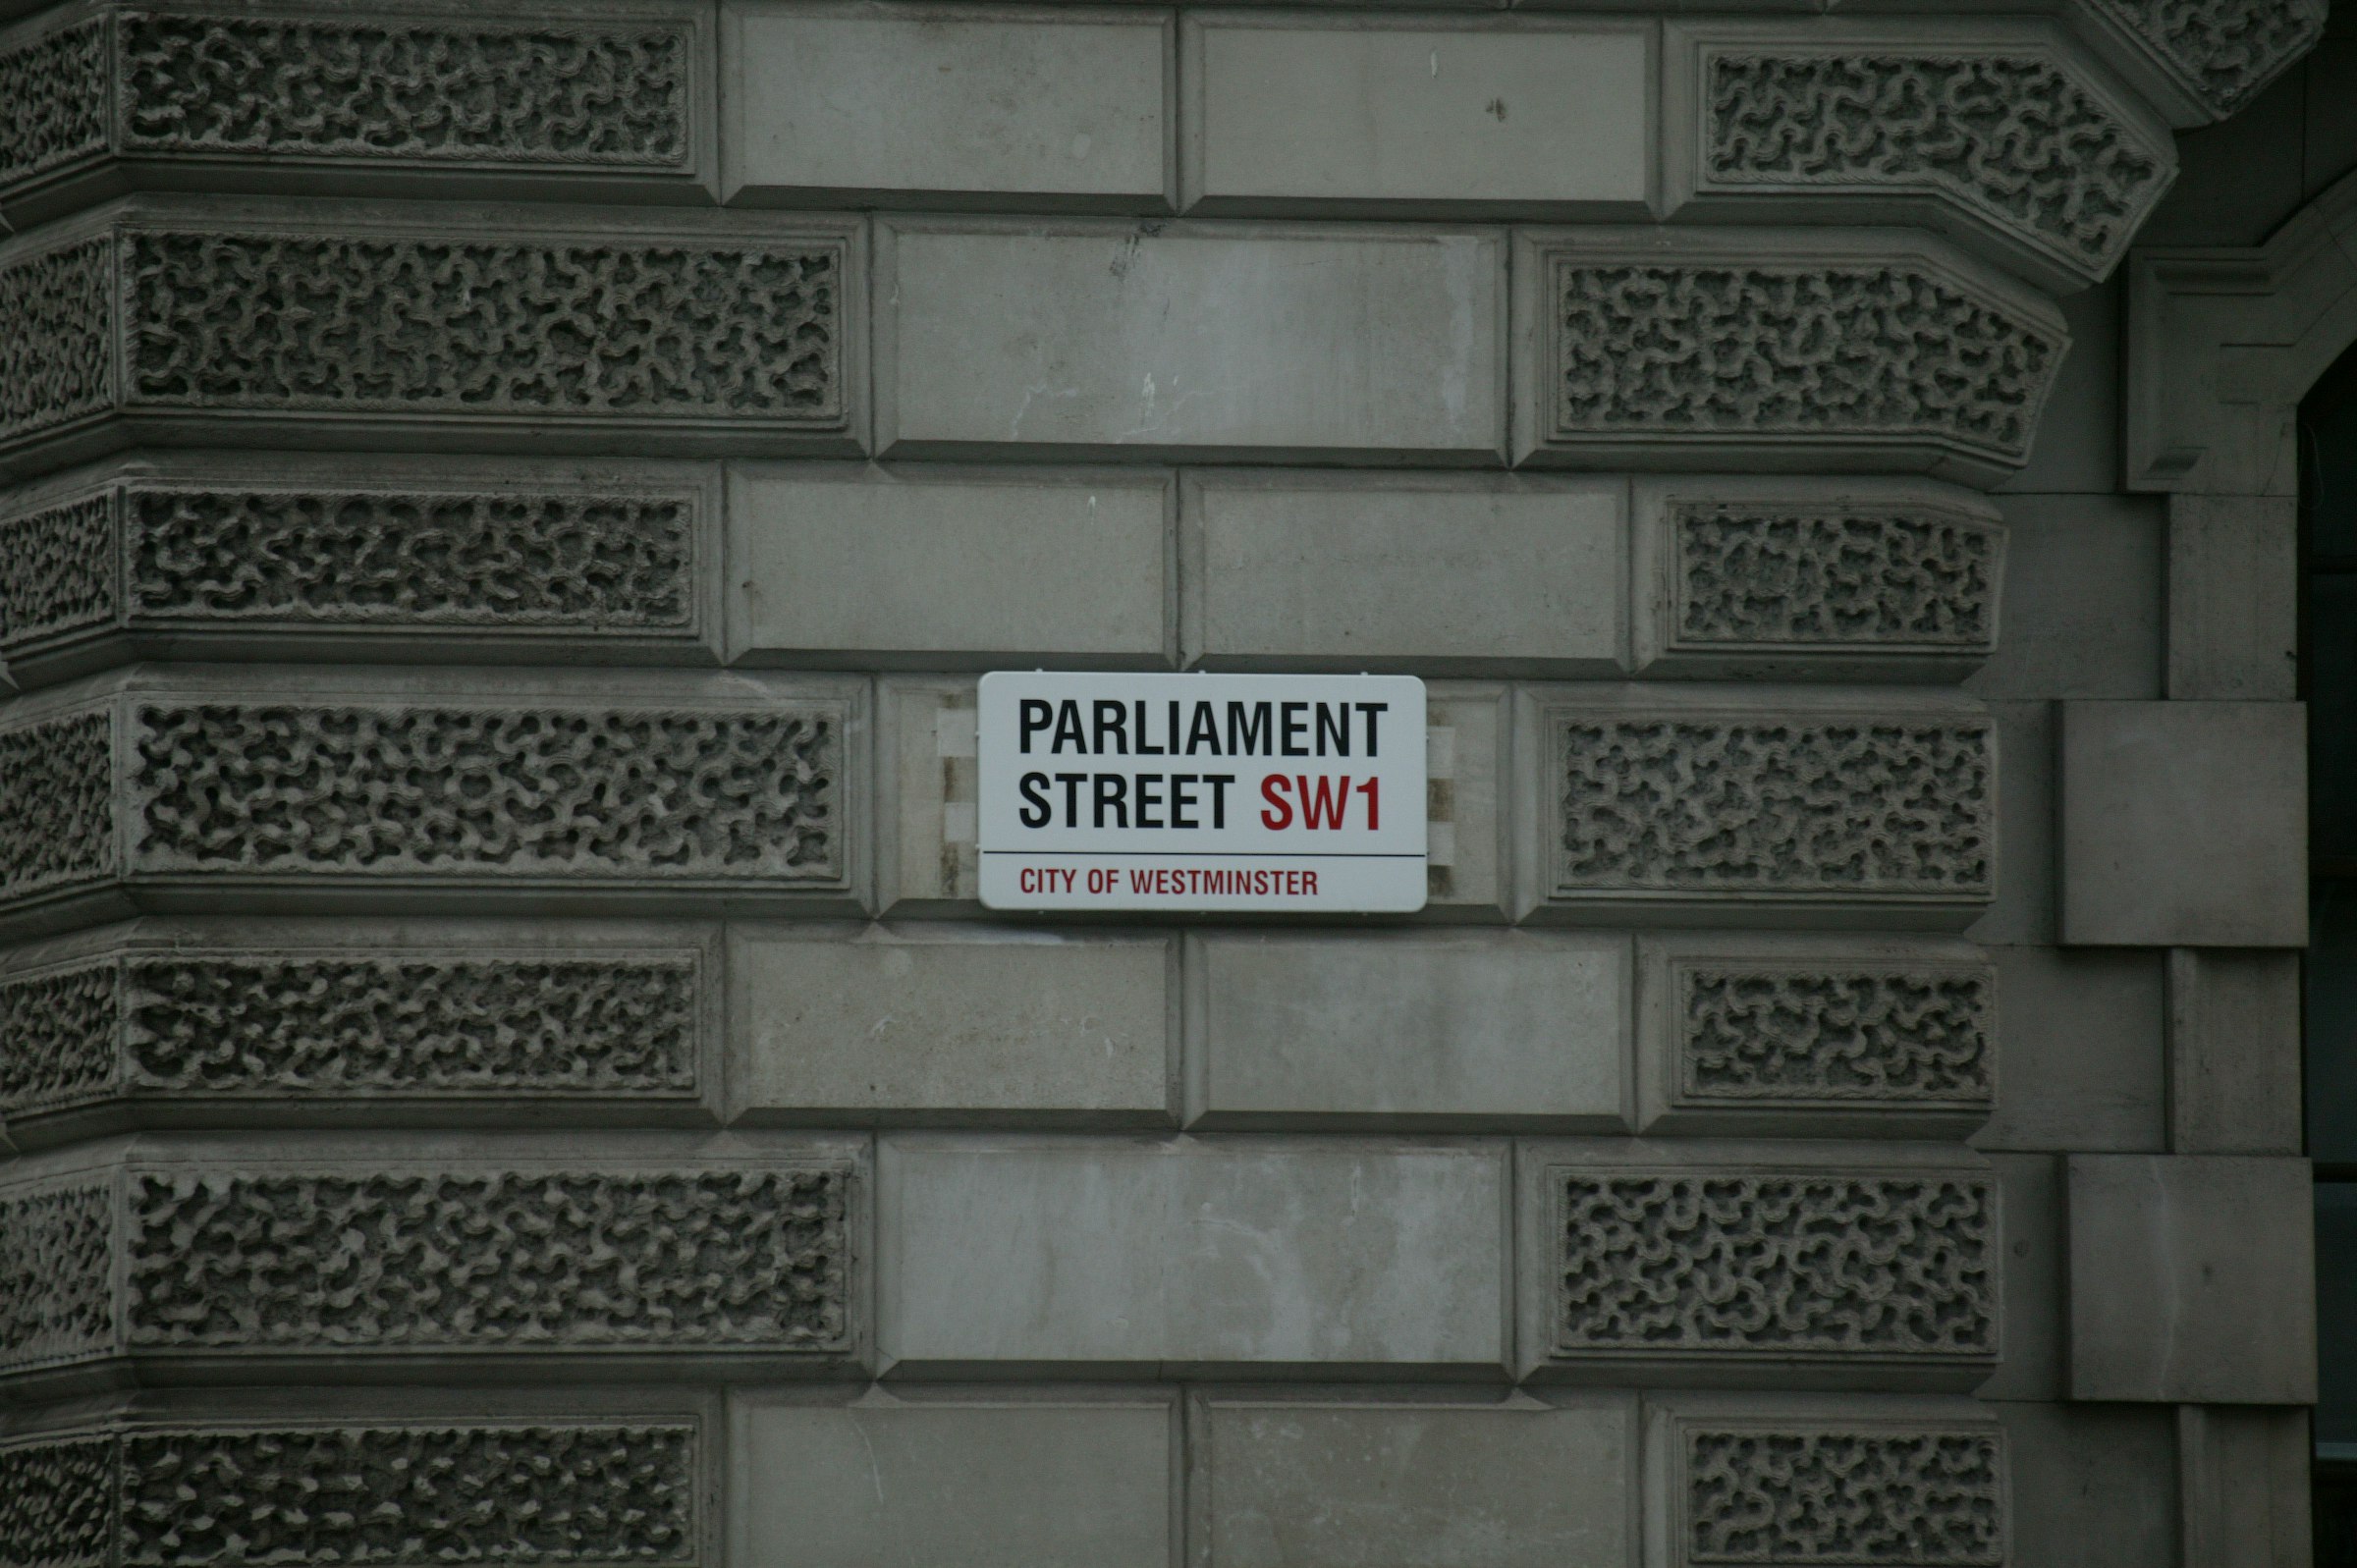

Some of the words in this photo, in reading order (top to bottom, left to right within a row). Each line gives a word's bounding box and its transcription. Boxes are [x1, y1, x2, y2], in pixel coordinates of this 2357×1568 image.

[1018, 698, 1389, 758] PARLIAMENT
[1018, 771, 1236, 830] STREET
[1260, 773, 1379, 832] SW1
[1019, 867, 1077, 894] CITY
[1087, 868, 1120, 894] OF
[1129, 869, 1319, 896] WESTMINSTER
